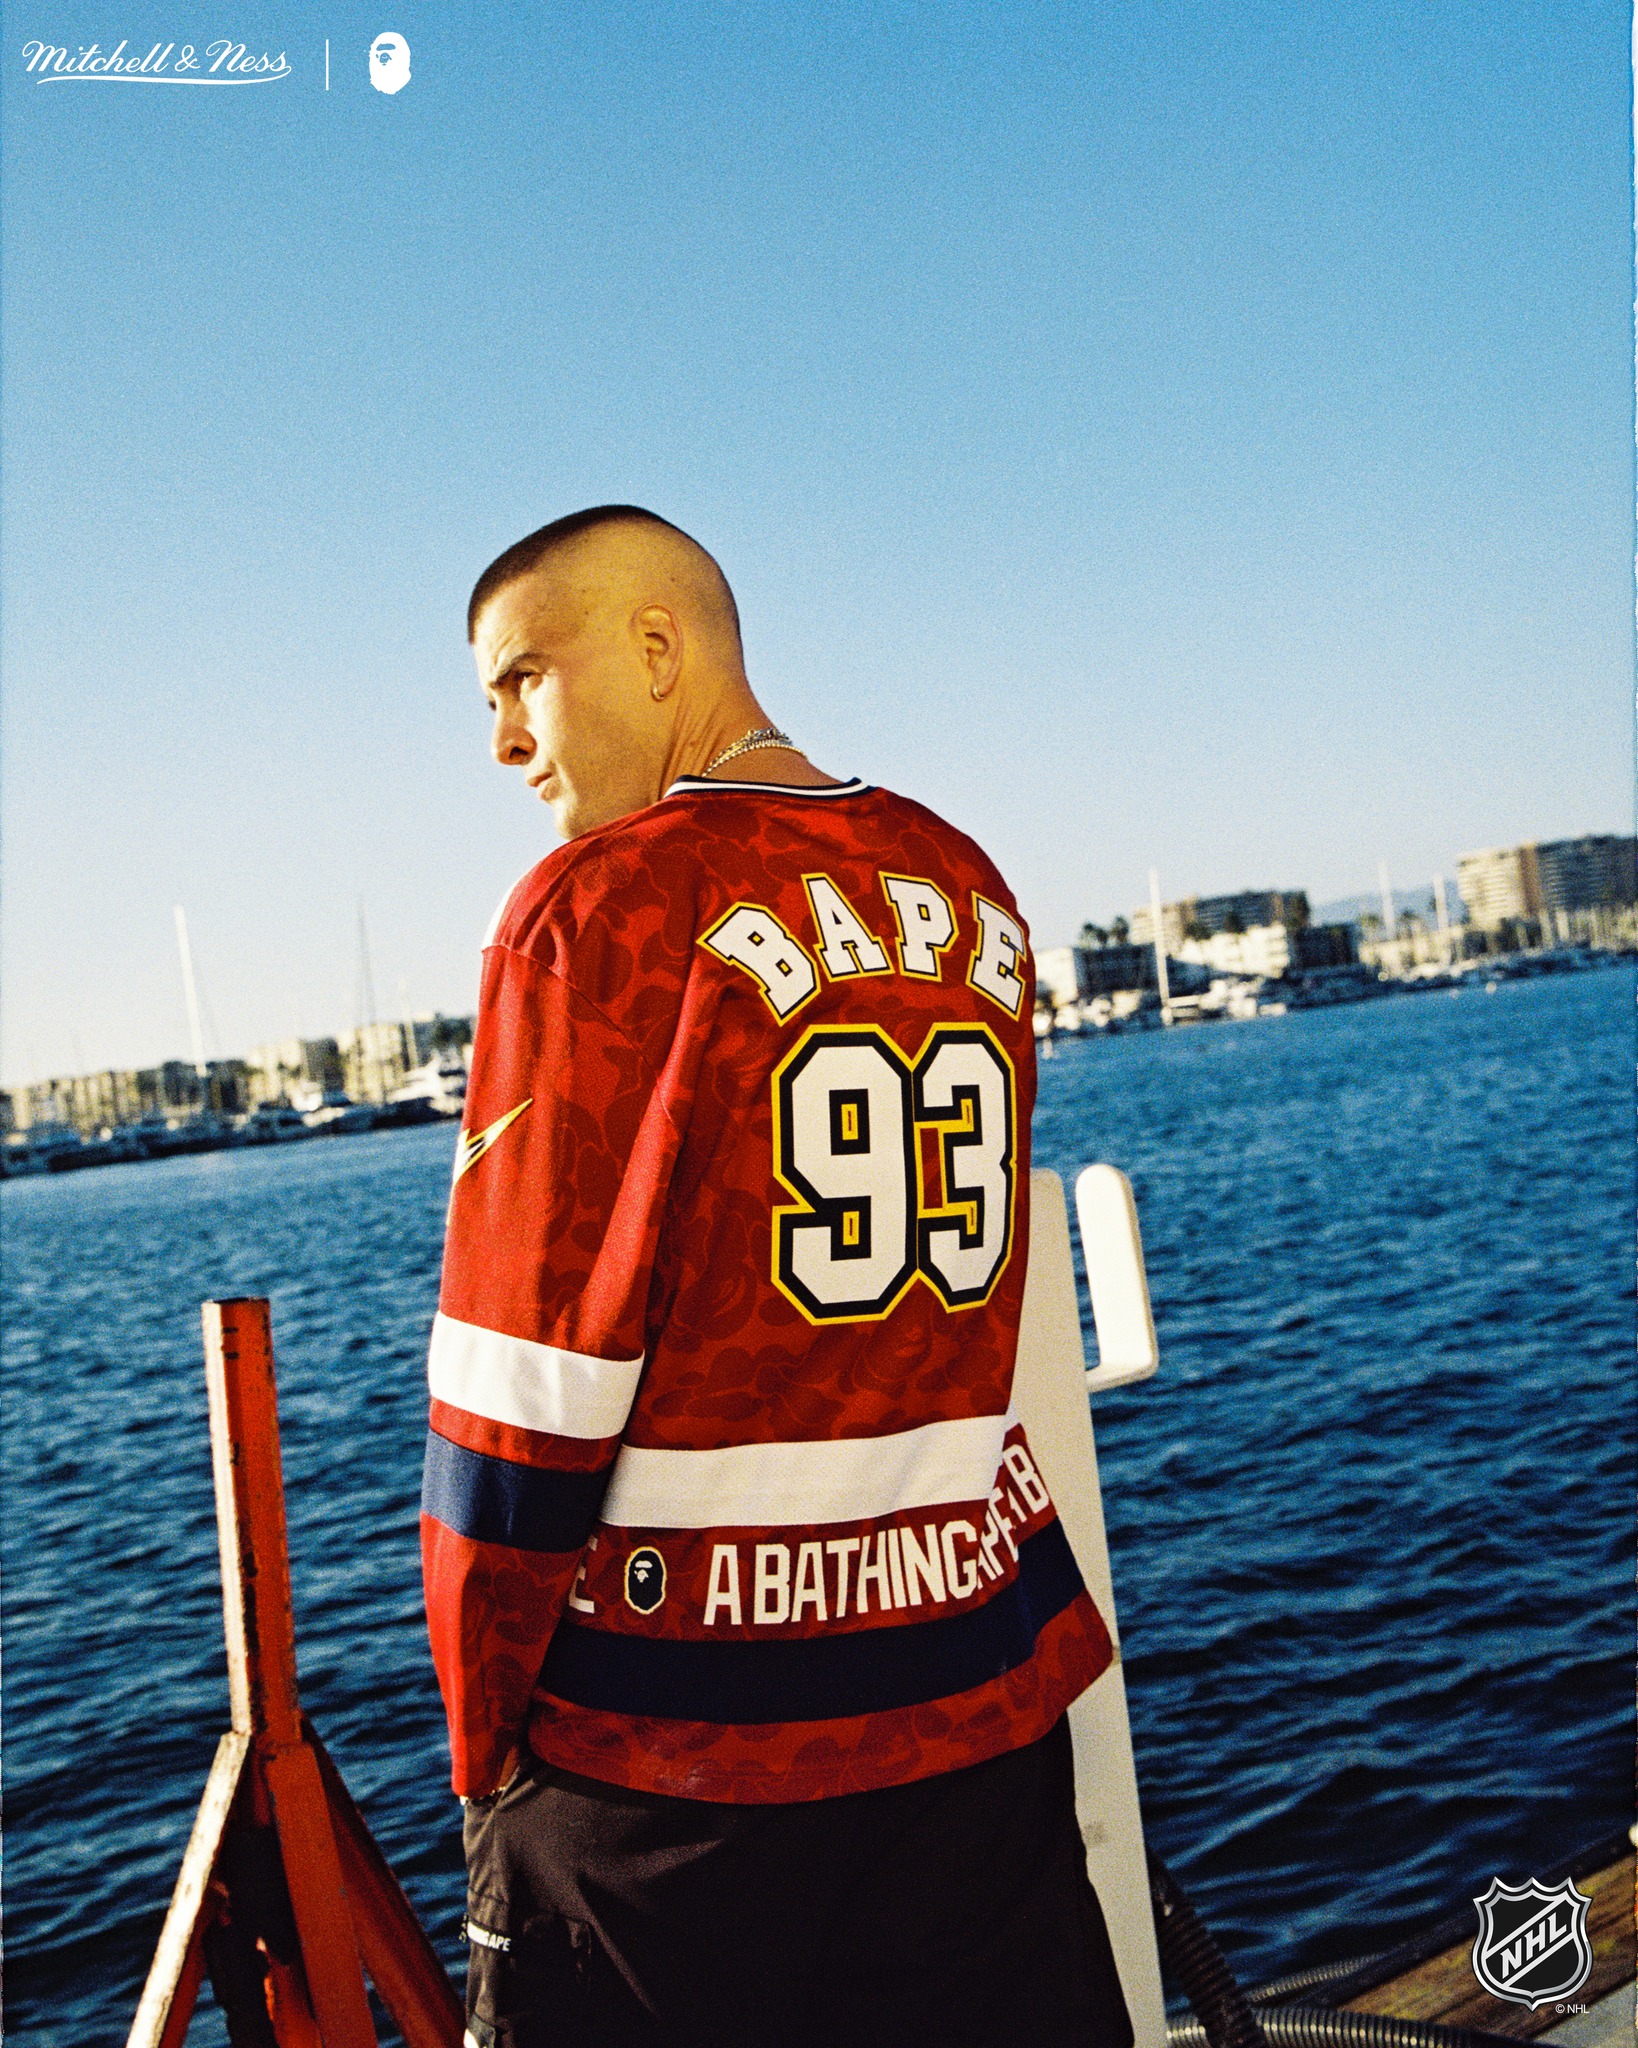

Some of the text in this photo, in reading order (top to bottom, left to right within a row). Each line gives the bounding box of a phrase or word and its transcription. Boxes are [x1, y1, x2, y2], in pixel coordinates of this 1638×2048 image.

[697, 872, 1026, 1027] BAPE
[771, 1022, 1017, 1326] 93
[703, 1543, 743, 1626] A
[753, 1519, 979, 1625] BATHING
